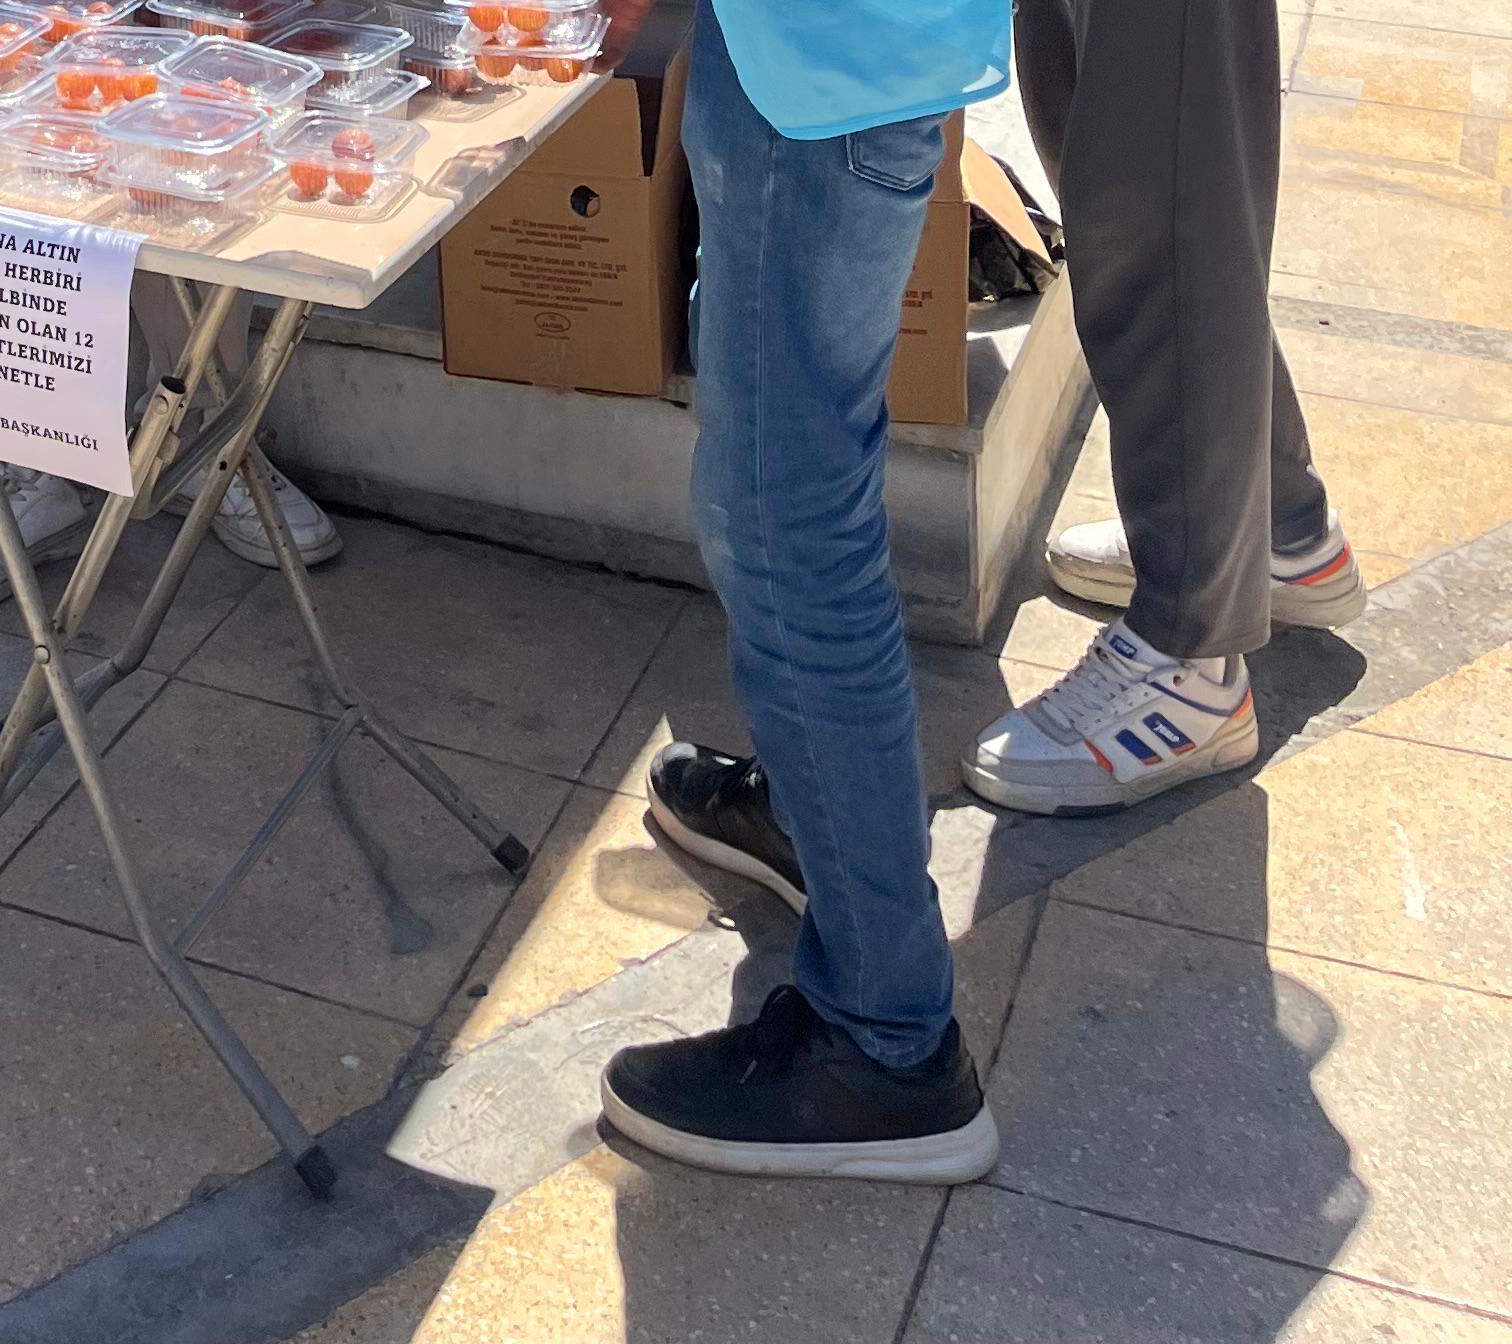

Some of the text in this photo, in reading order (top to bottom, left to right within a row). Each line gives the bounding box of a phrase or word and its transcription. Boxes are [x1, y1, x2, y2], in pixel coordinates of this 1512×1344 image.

[22, 238, 81, 264] ALTIN
[4, 262, 82, 292] HERBİRİ
[16, 318, 68, 342] OLAN
[74, 331, 94, 348] 12
[0, 416, 99, 452] BAŞKANLIĞI
